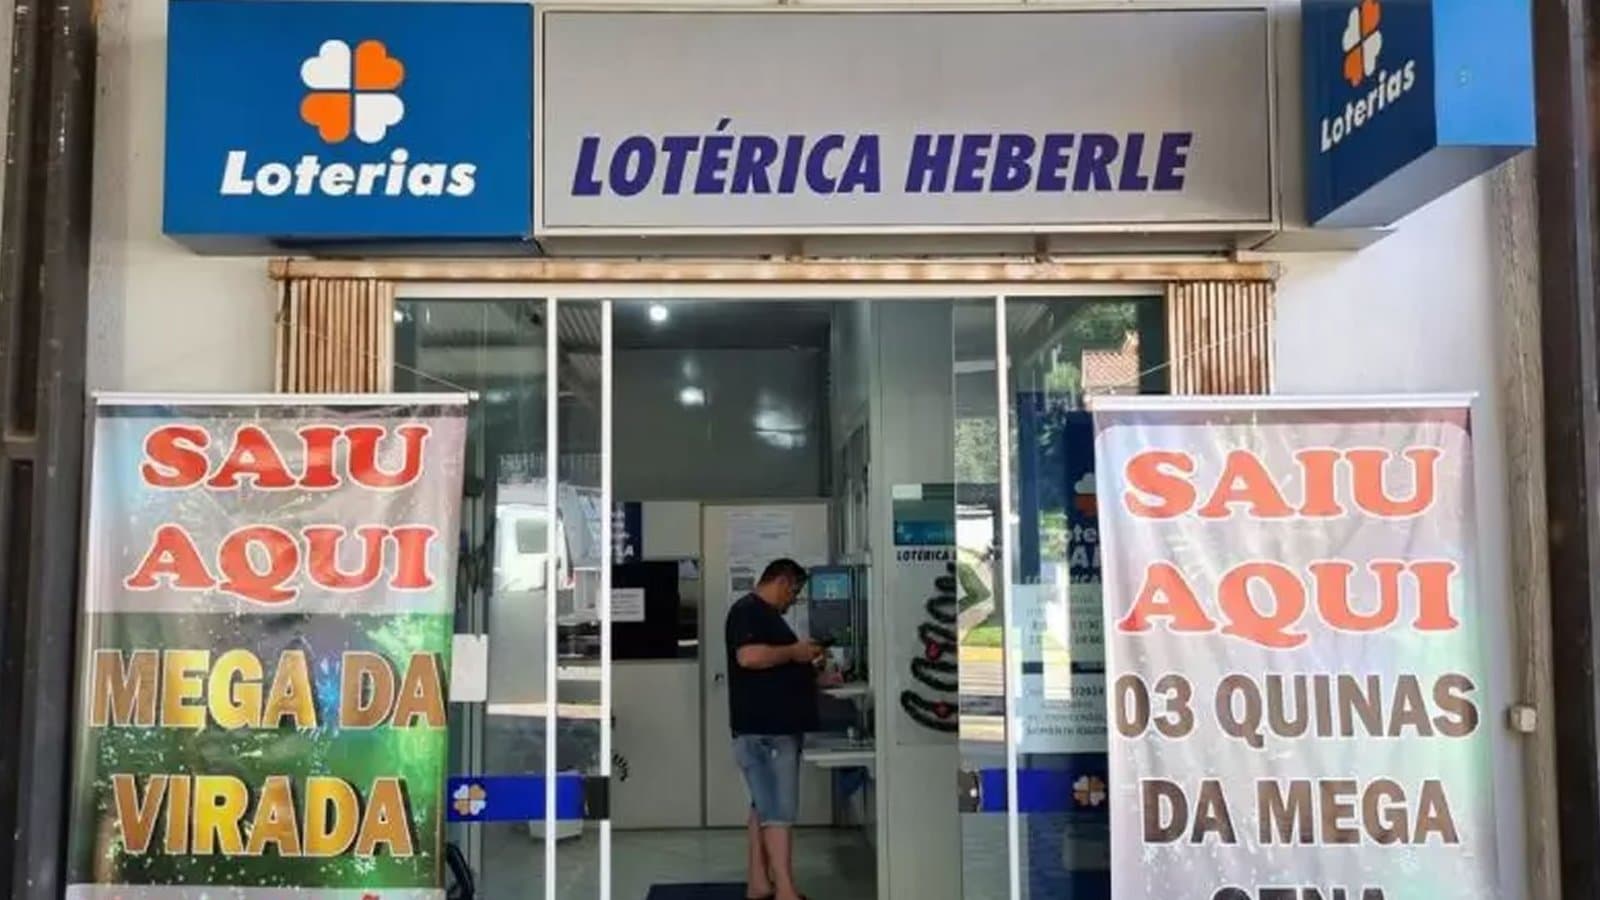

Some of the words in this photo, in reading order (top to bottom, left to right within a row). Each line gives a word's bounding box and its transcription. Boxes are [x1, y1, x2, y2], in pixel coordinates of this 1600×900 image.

[1320, 59, 1415, 153] Loterias
[220, 148, 477, 196] Loterias
[571, 118, 881, 196] LOTÉRICA
[904, 132, 1193, 193] HEBERLE
[140, 424, 431, 491] SAIU
[1123, 448, 1441, 520] SAIU
[125, 524, 436, 603] AQUI
[1117, 561, 1460, 648] AQUI
[91, 649, 317, 729] MEGA
[340, 651, 447, 729] DA
[1116, 674, 1194, 739] 03
[1215, 674, 1480, 749] QUINAS
[112, 775, 415, 857] VIRADA
[1141, 779, 1237, 845] DA
[1257, 779, 1460, 845] MEGA
